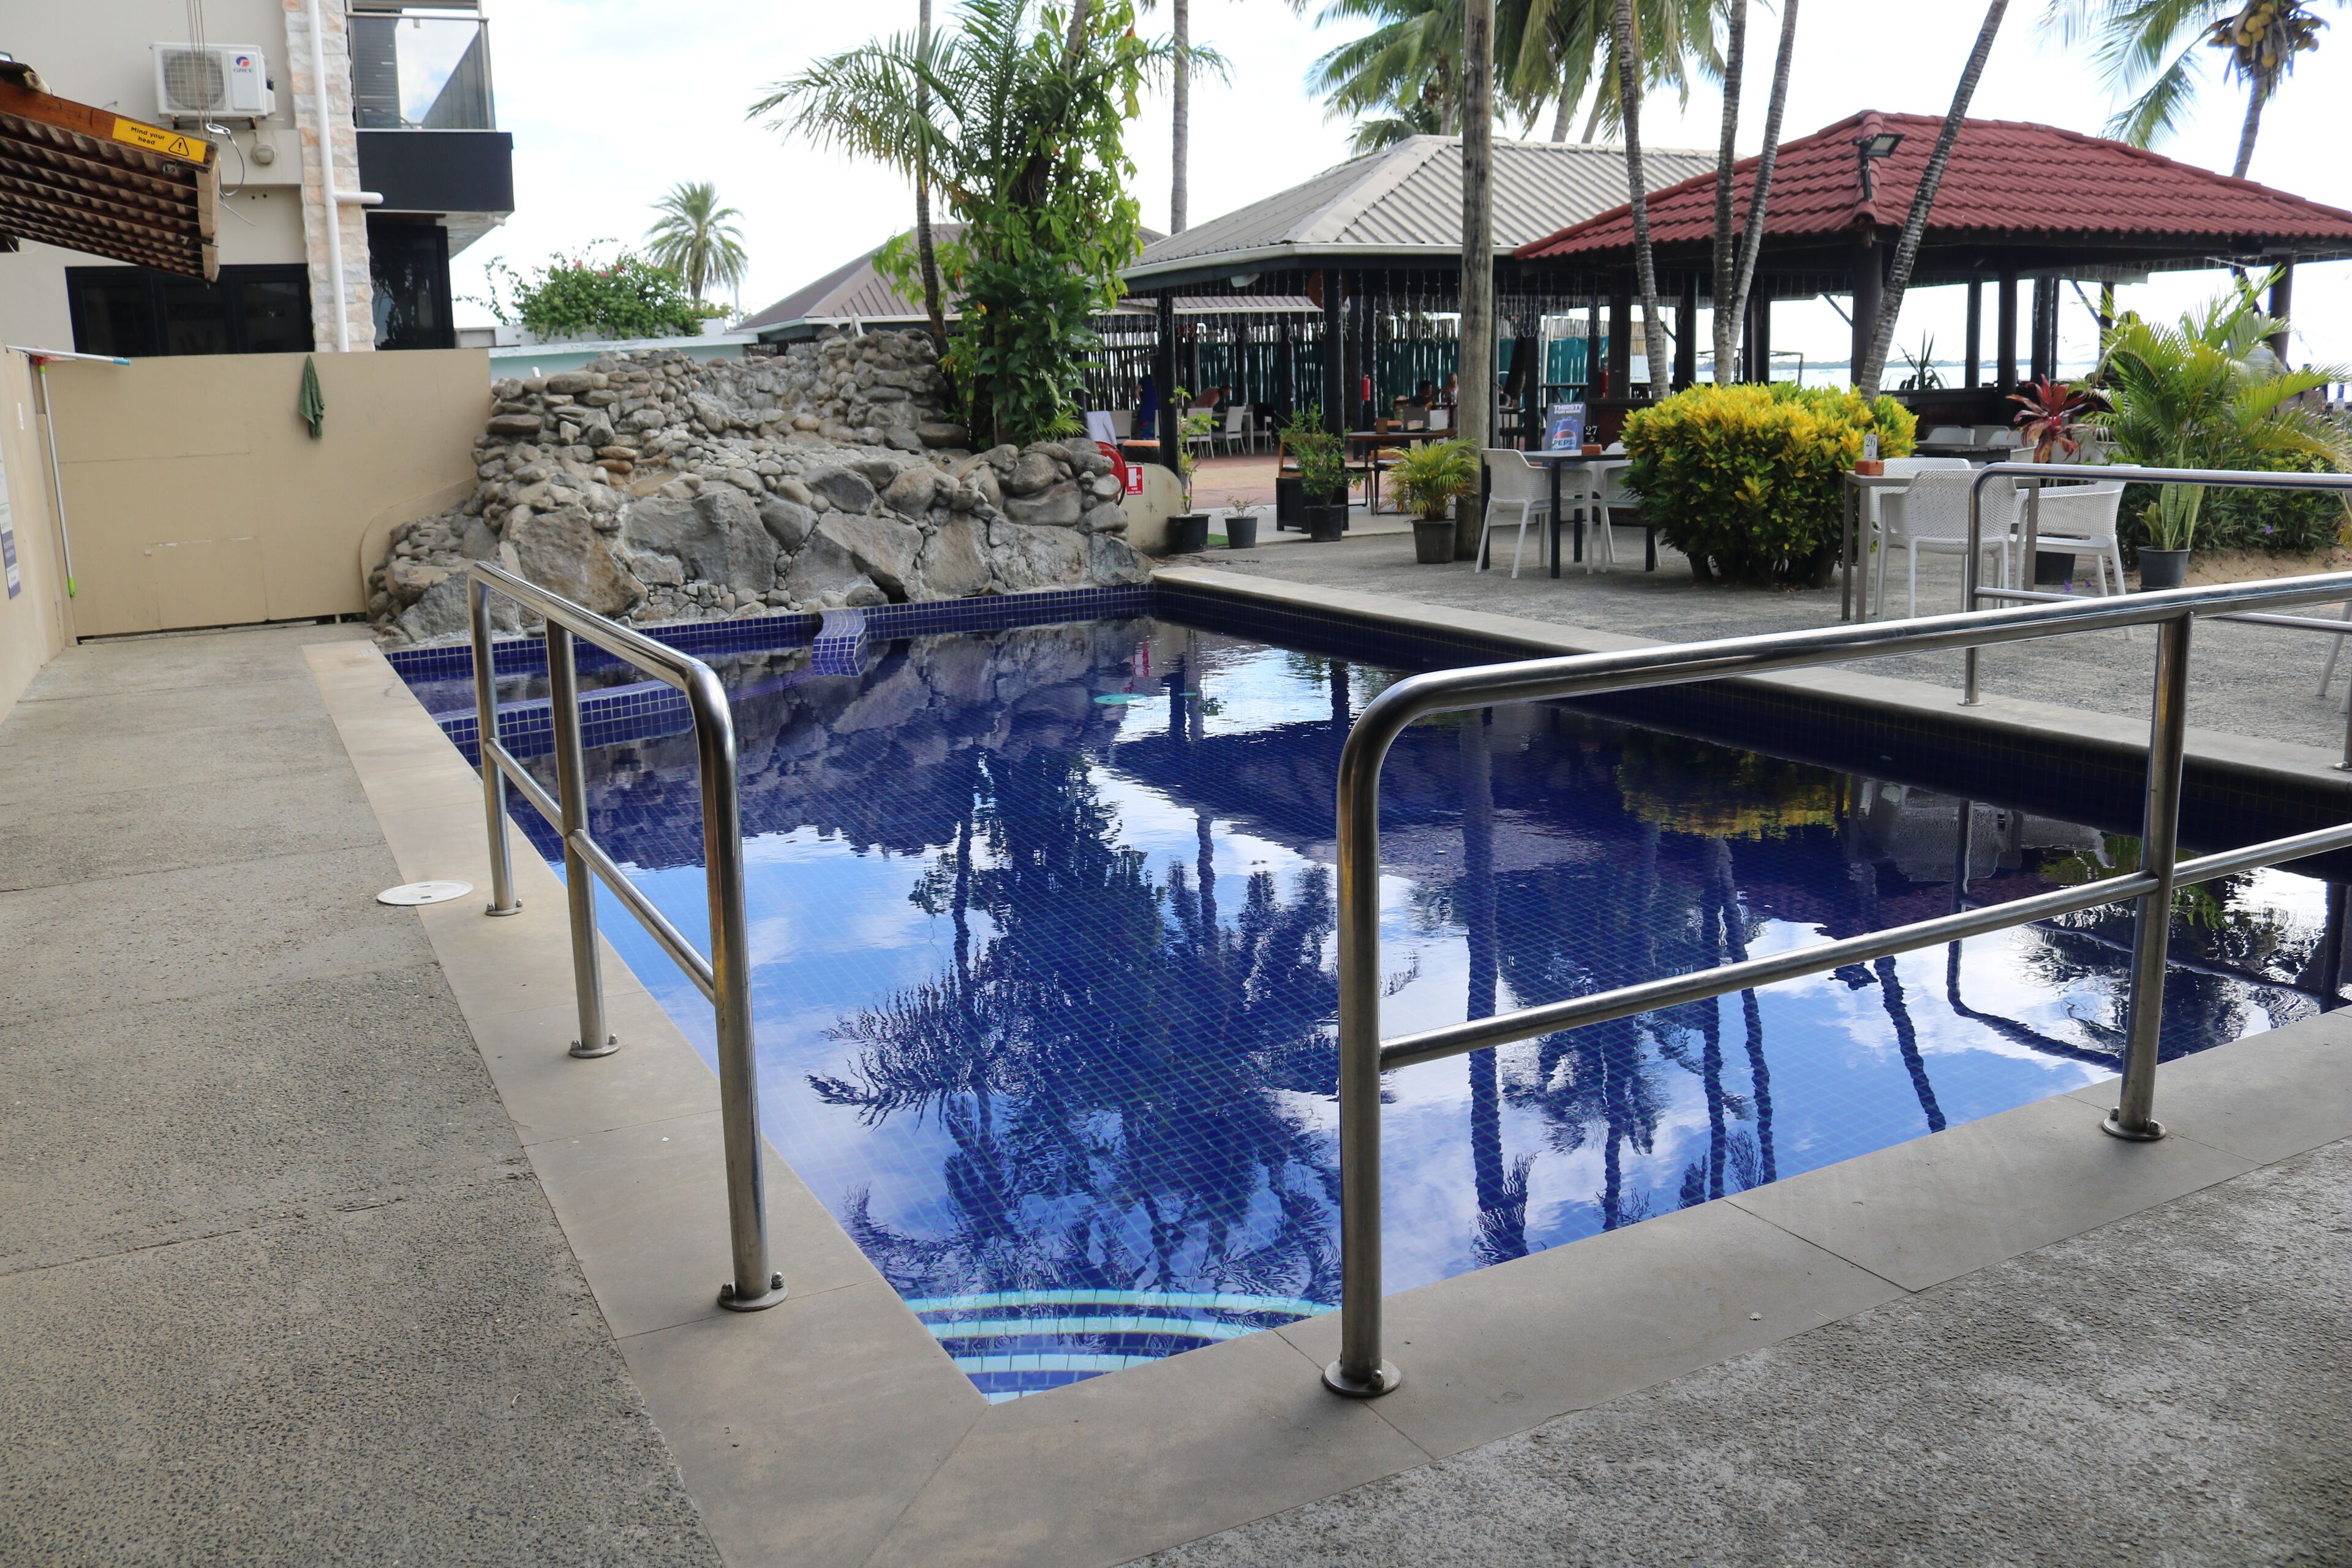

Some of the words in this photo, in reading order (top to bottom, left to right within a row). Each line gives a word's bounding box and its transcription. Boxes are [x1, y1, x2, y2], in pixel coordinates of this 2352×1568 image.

[130, 127, 148, 135] Mind
[138, 136, 155, 145] head
[1585, 425, 1598, 435] 27
[1866, 435, 1875, 447] 26
